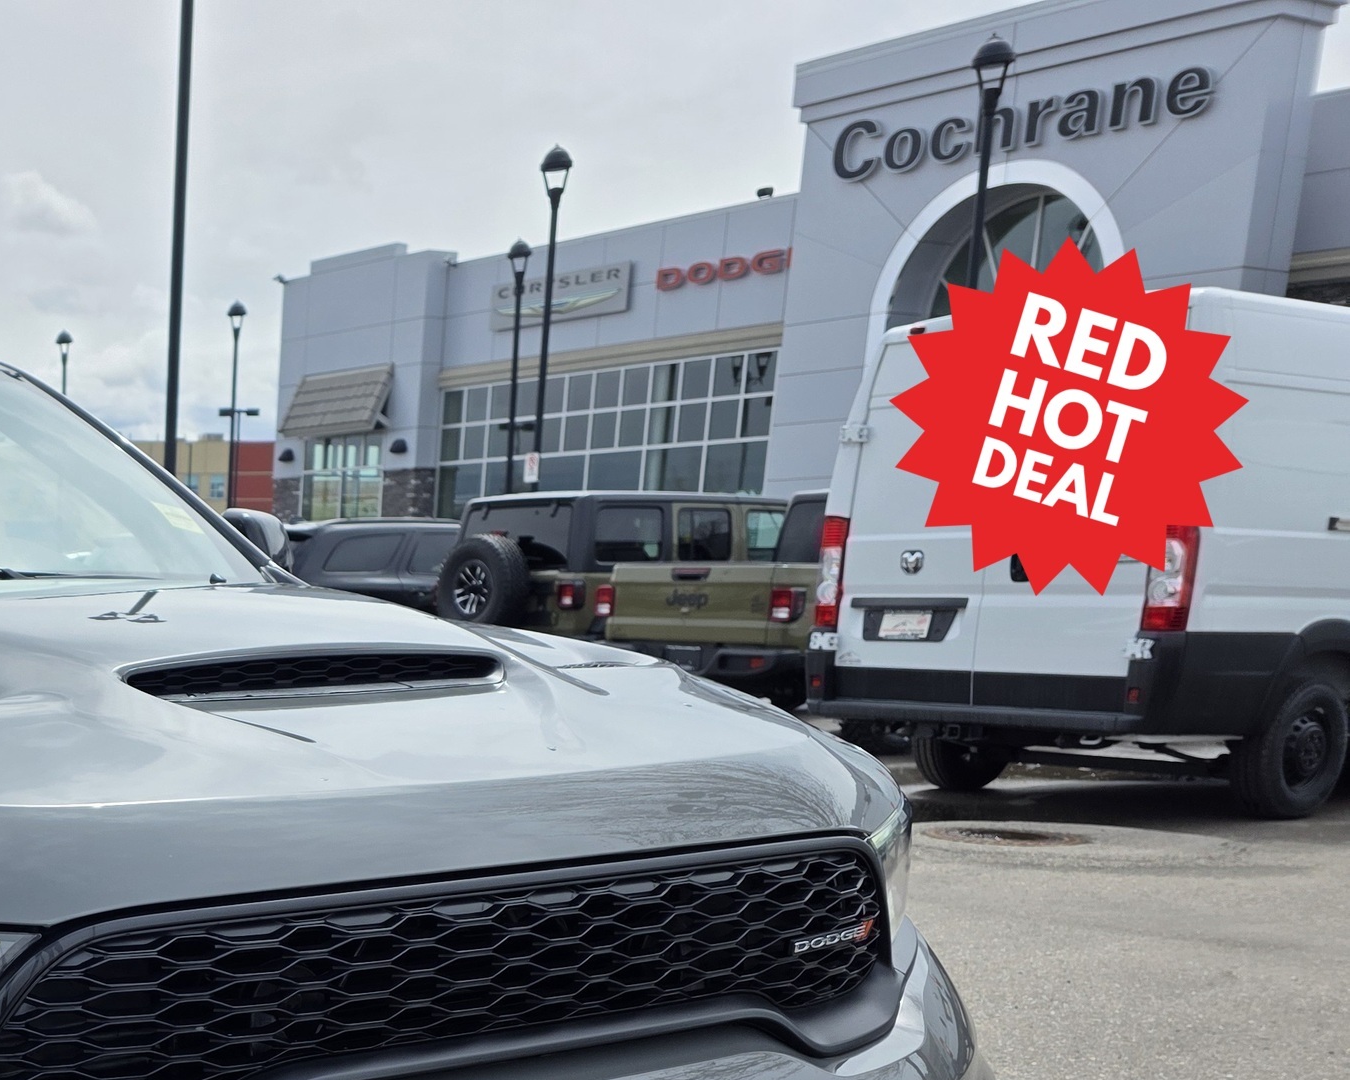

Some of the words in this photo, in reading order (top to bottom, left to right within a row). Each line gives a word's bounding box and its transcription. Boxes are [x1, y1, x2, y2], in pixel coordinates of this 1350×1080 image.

[833, 66, 1214, 182] Cochrane
[498, 267, 621, 299] CRSLER
[794, 924, 867, 953] DODGE
